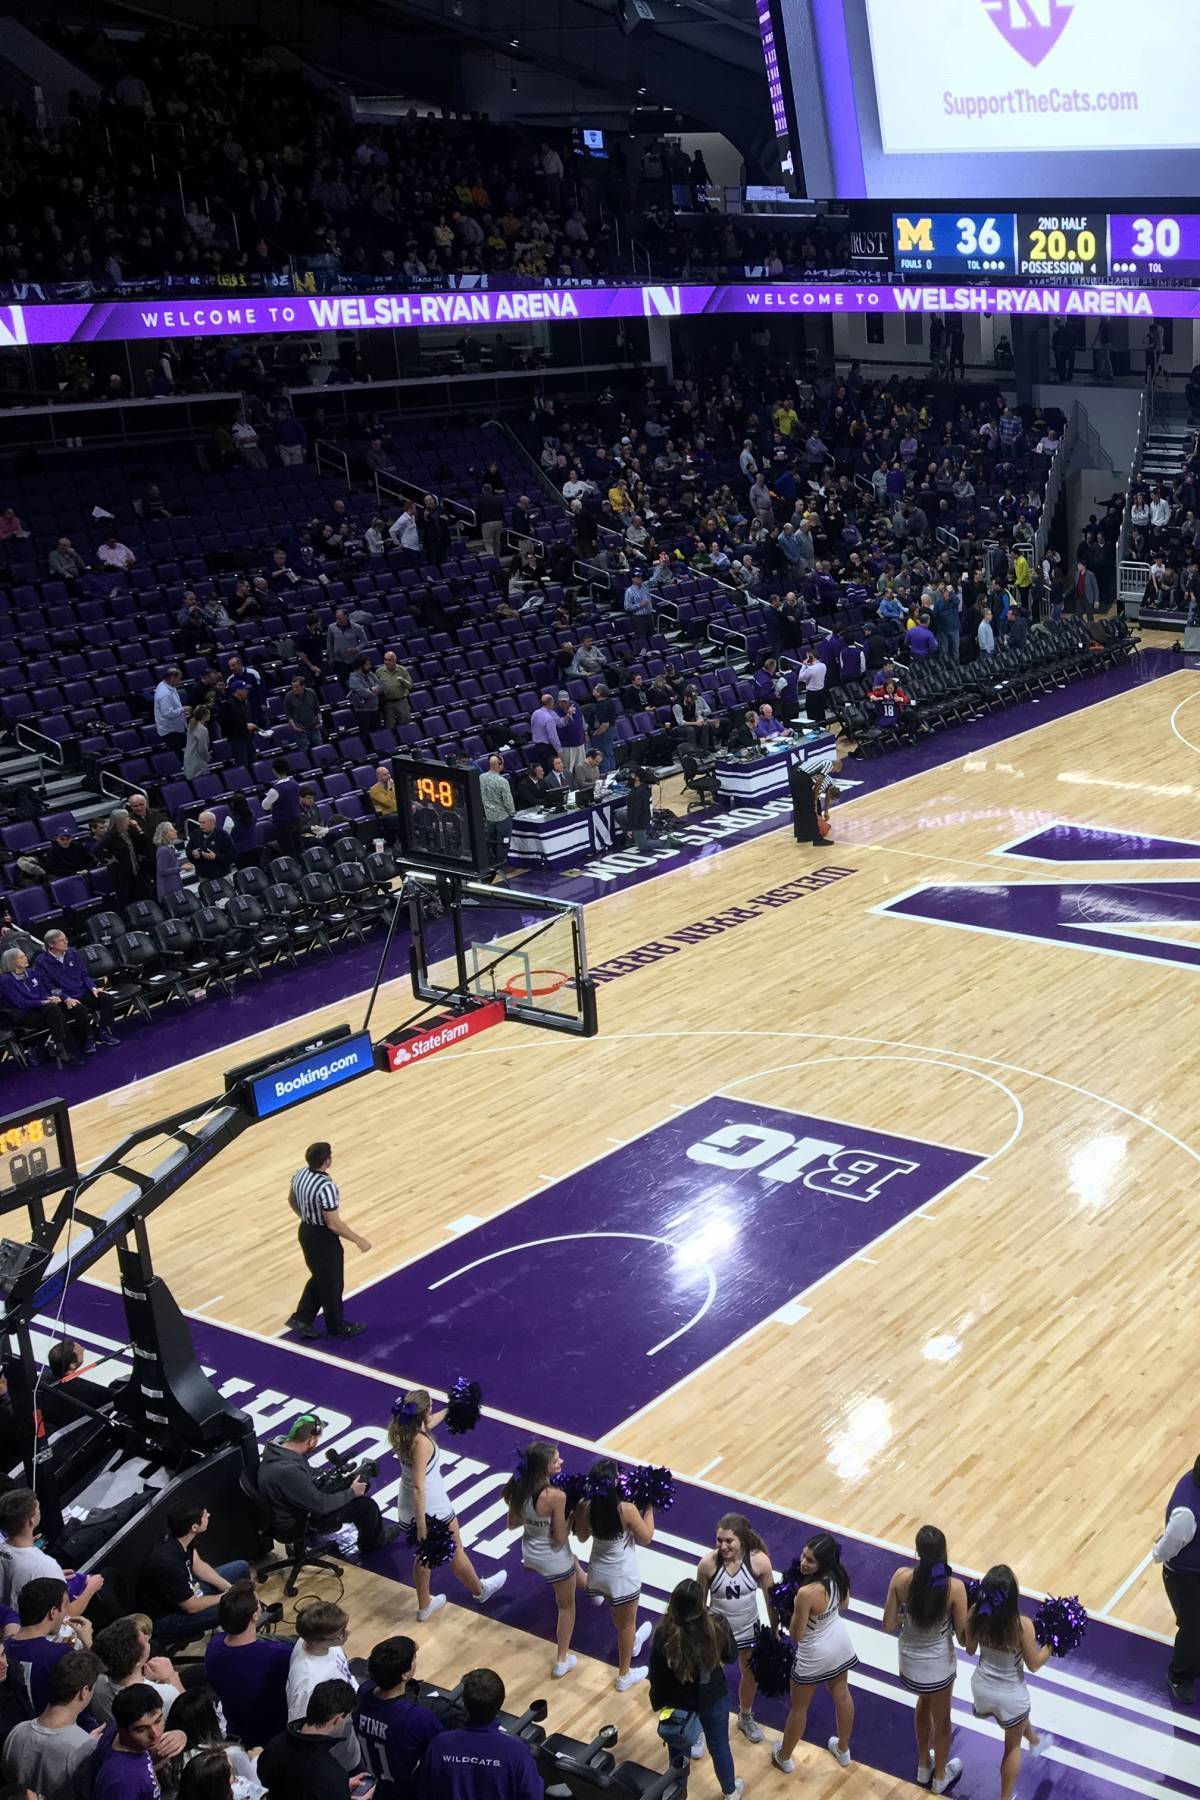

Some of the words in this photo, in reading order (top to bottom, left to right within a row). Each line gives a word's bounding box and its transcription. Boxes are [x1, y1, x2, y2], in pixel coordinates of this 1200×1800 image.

[942, 88, 1138, 119] SupportTheCats.com
[897, 218, 934, 250] M
[956, 218, 1001, 254] 36
[1039, 217, 1058, 230] 2ND
[1061, 217, 1087, 230] HALF
[1132, 218, 1180, 257] 30
[1029, 230, 1096, 260] 20.0
[901, 259, 922, 270] FOULS
[926, 260, 932, 270] 0
[967, 260, 981, 270] TOL
[1021, 261, 1083, 274] POSSESSION
[1149, 263, 1162, 273] TOL
[141, 308, 256, 328] WELCOME
[269, 306, 296, 322] TO
[308, 296, 489, 328] WELSH-RYAN
[495, 292, 578, 320] ARENA
[642, 286, 681, 316] N
[745, 292, 844, 306] WELCOME
[855, 292, 880, 305] TO
[893, 287, 1060, 312] WELSH-RYAN
[1066, 290, 1154, 316] ARENA
[884, 705, 894, 716] 18
[592, 805, 613, 850] N
[664, 866, 858, 945] WELSH-RYAN
[275, 1052, 358, 1098] Booking.com
[726, 1586, 740, 1600] N
[359, 1714, 388, 1740] FINK
[442, 1754, 501, 1768] WILDCATS
